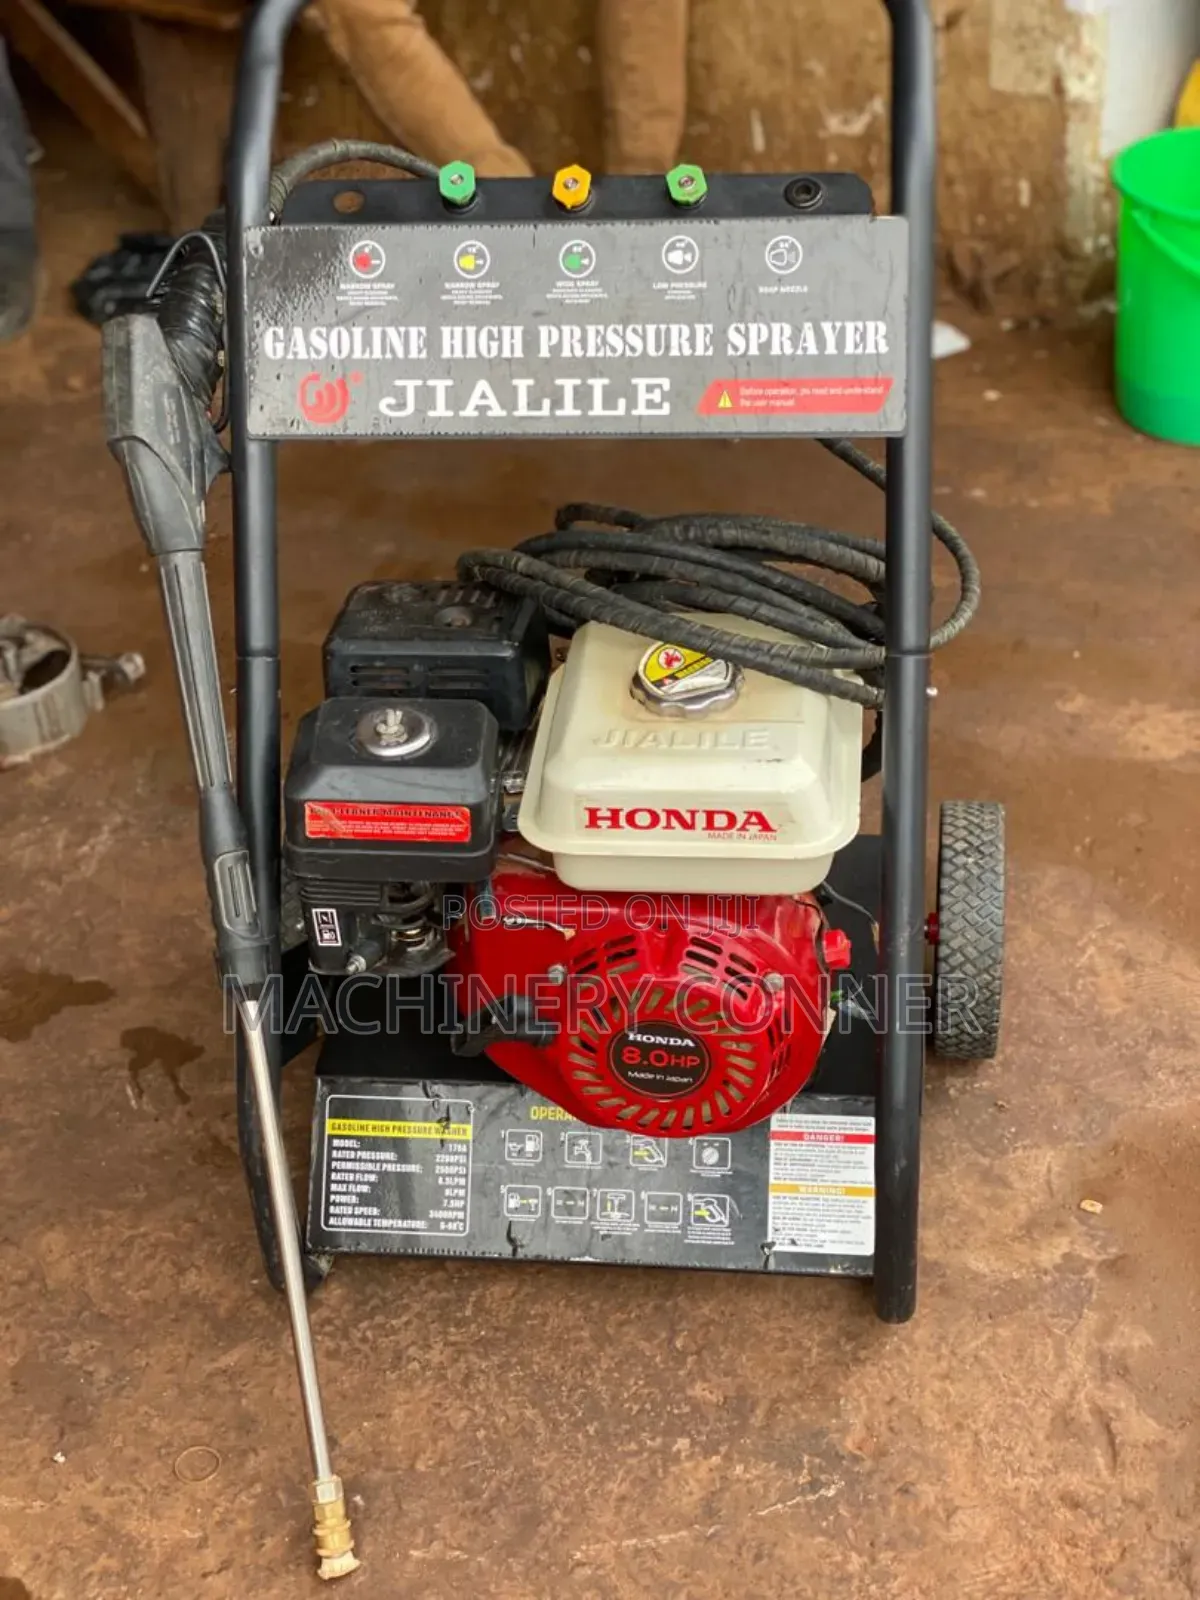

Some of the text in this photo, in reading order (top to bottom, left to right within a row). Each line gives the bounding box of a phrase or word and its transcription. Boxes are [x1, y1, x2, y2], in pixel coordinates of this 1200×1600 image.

[263, 320, 890, 360] GASOLINE HIGH PRESSURE SPRAYER
[378, 377, 671, 417] JIALILE
[594, 728, 770, 749] JIALILE
[584, 807, 777, 832] HONDA
[708, 832, 733, 840] MADE
[749, 833, 777, 842] JAPAN
[628, 1032, 695, 1047] HONDA
[628, 1070, 655, 1079] Made
[331, 1122, 369, 1132] GASOLINE
[371, 1124, 390, 1133] HIGH
[392, 1125, 434, 1135] PRESSURE
[331, 1150, 356, 1159] RATED
[330, 1171, 355, 1181] RATED
[329, 1205, 353, 1215] RATED
